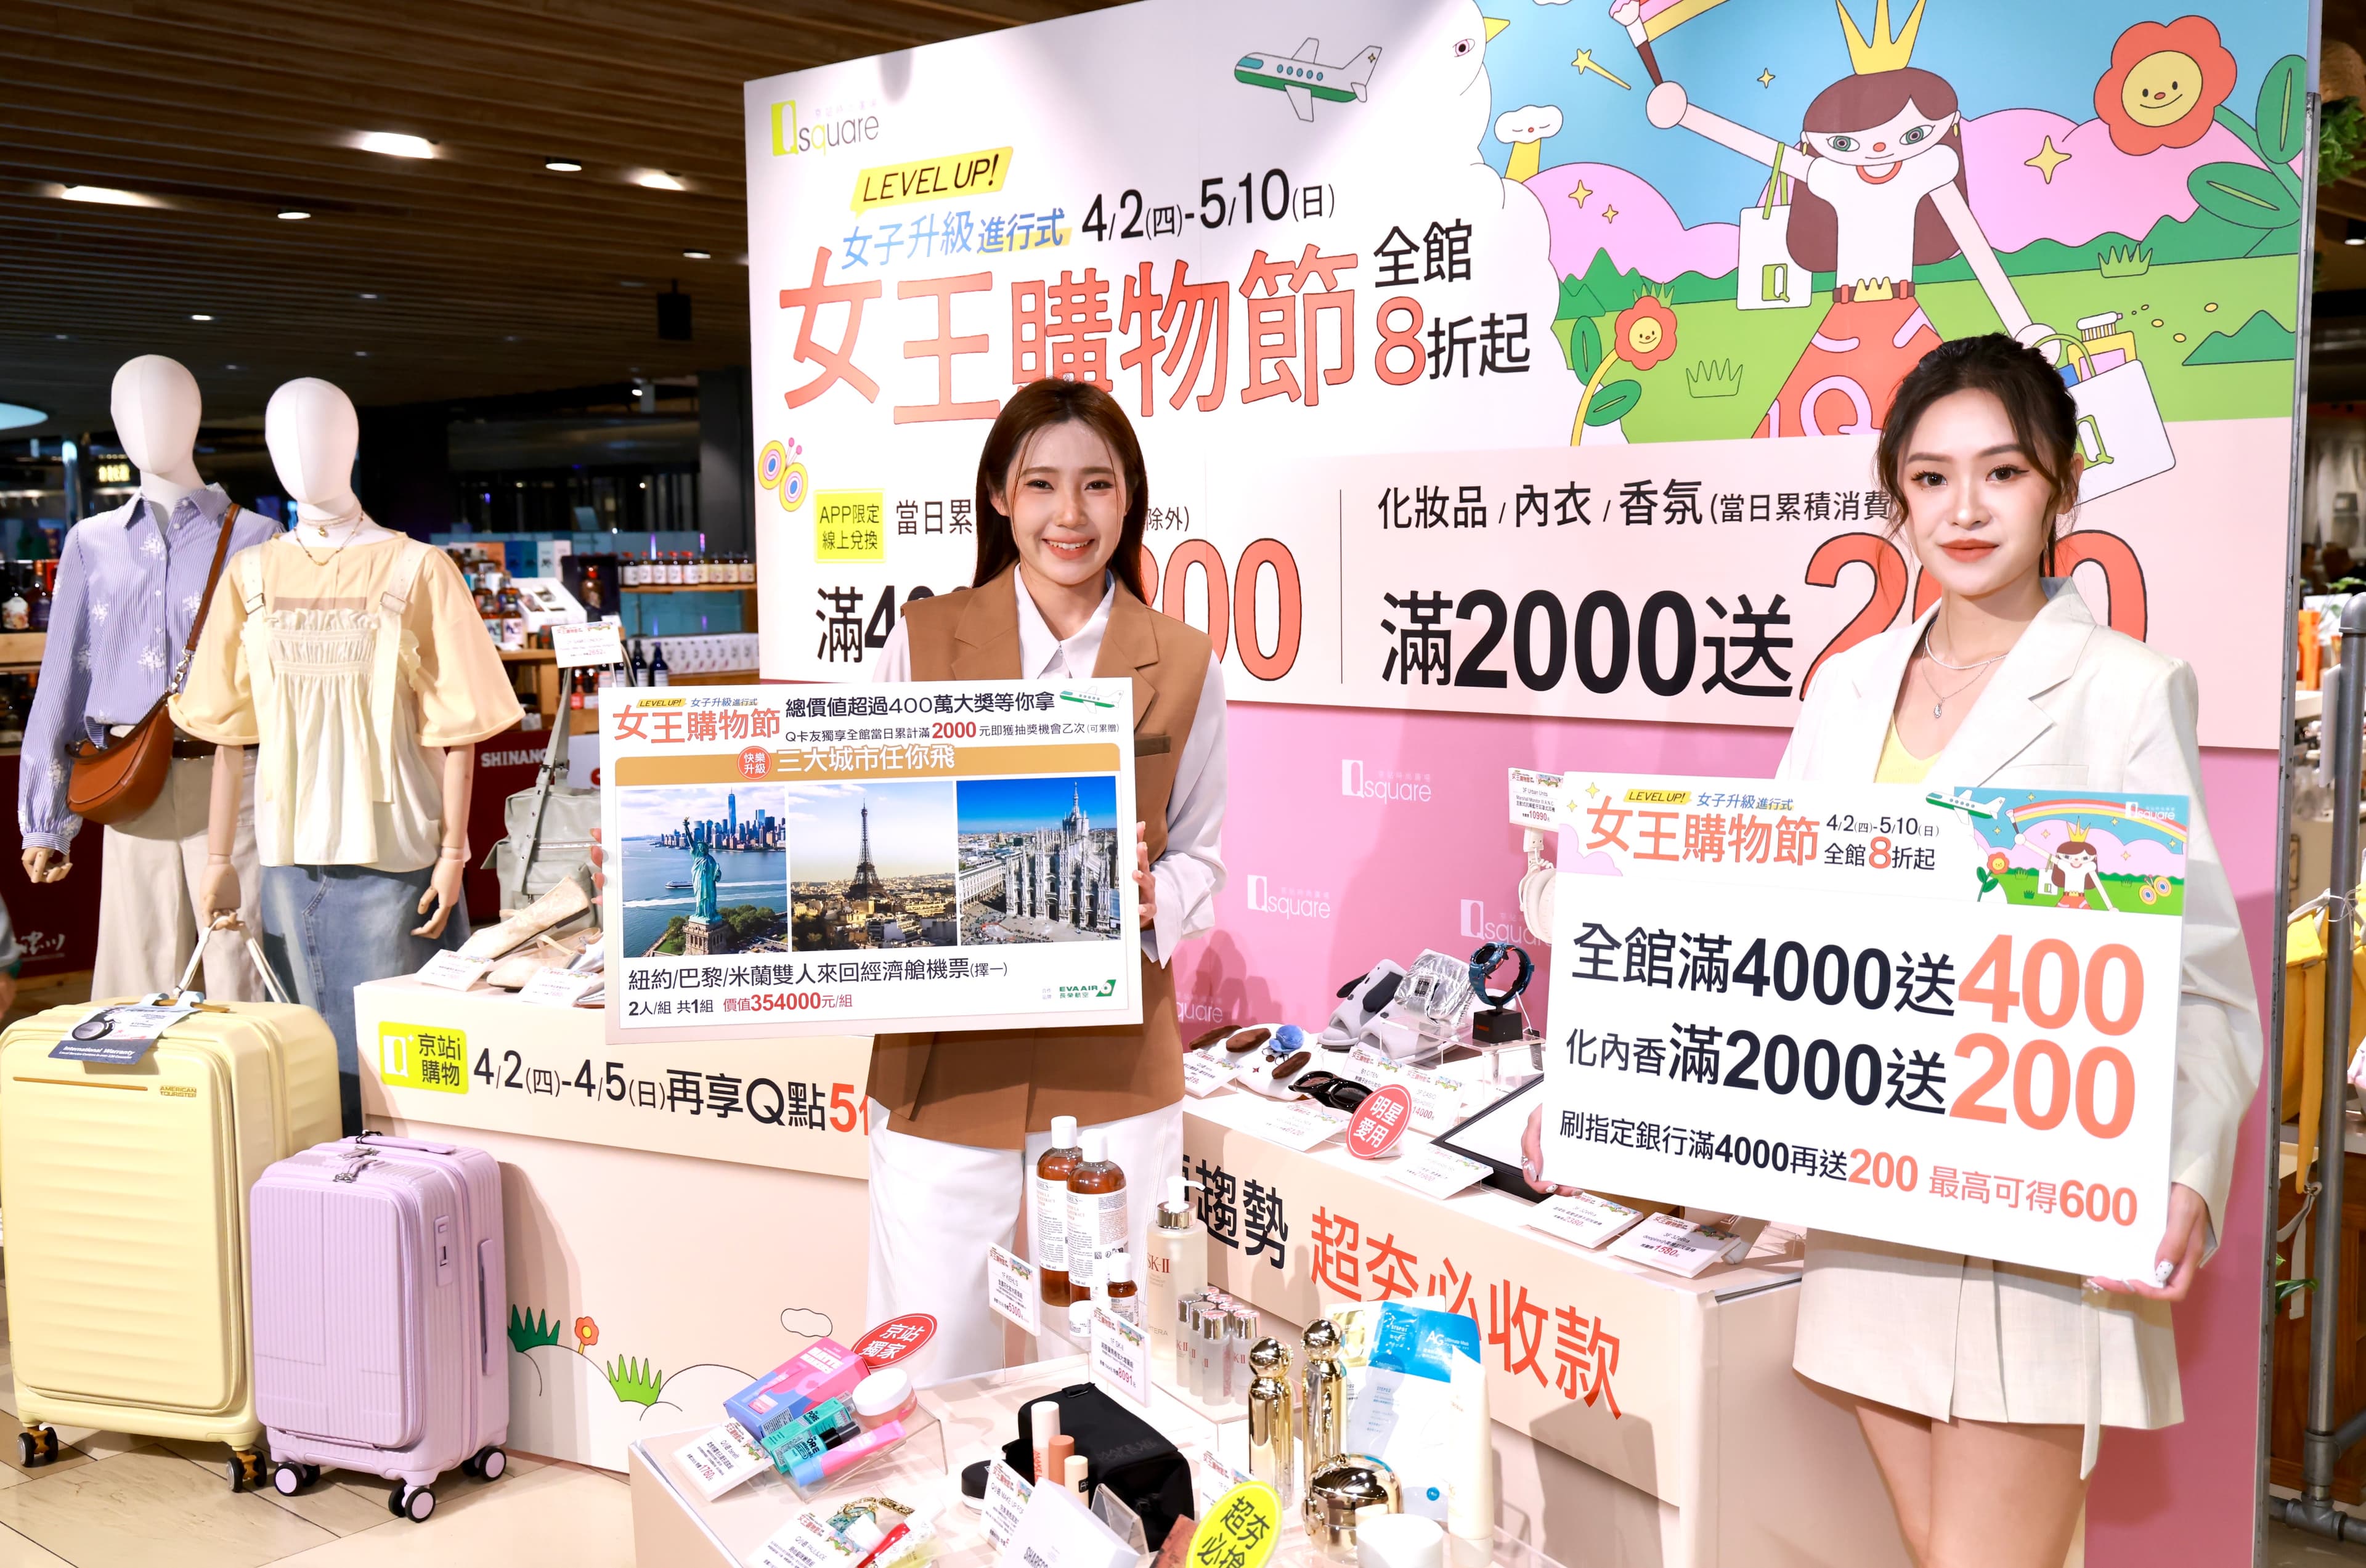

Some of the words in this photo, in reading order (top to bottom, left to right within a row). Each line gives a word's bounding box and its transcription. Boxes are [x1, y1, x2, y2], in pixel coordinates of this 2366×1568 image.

[863, 166, 949, 202] LEVEL
[954, 153, 999, 189] UP!
[1082, 168, 1335, 242] 4/2(四)-5/10(日)
[842, 208, 1065, 270] 女子升級進行式
[1373, 218, 1473, 288] 全館
[779, 243, 1358, 425] 女王購物節
[1375, 296, 1531, 386] 8折起
[819, 503, 880, 526] APP限定
[896, 499, 973, 535] 當日累
[822, 529, 878, 552] 線上兌換
[817, 585, 974, 663] 滿4
[1139, 537, 1303, 681] 00
[667, 699, 682, 707] UP!
[691, 697, 758, 708] 女子升級進行式
[785, 691, 1055, 718] 總價值超過400萬大獎等你拿
[612, 704, 780, 744] 女王購物節
[744, 752, 765, 764] 快樂
[744, 763, 766, 775] 升級
[776, 743, 955, 774] 三大城市任你飛
[1342, 758, 1431, 805] Qsquare
[1628, 792, 1665, 802] LEVEL
[1666, 793, 1686, 803] UP!
[1697, 792, 1794, 811] 女子升級進行式
[1586, 795, 1820, 866] 女王購物節
[1824, 836, 1935, 871] 全館8折起
[1247, 874, 1330, 920] Qsquare
[628, 957, 1007, 990] 紐約/巴黎/米蘭雙人來回經濟艙機票(擇一)
[1572, 922, 2144, 1036] 全館滿4000送400
[628, 1000, 672, 1017] 2人/組
[677, 999, 714, 1014] 共1組
[723, 991, 853, 1012] 價值354000元/組
[103, 1046, 136, 1055] Warranty
[422, 1060, 460, 1086] 購物
[1566, 1022, 2136, 1139] 化內香滿2000送200
[473, 1048, 869, 1136] 4/2(四)-4/5(日)再享Q點5
[1370, 1095, 1405, 1127] 明星
[1353, 1116, 1390, 1148] 愛用
[1559, 1110, 1919, 1192] 刷指定銀行滿4000再送200
[1929, 1165, 2138, 1227] 最高可得600
[1182, 1153, 1288, 1270] 趨勢
[1147, 1252, 1171, 1274] SK-II
[858, 1339, 907, 1359] 獨家
[879, 1323, 925, 1343] 京站
[1426, 1330, 1445, 1346] AG
[806, 1437, 820, 1455] ORE
[1221, 1495, 1270, 1550] 超夯
